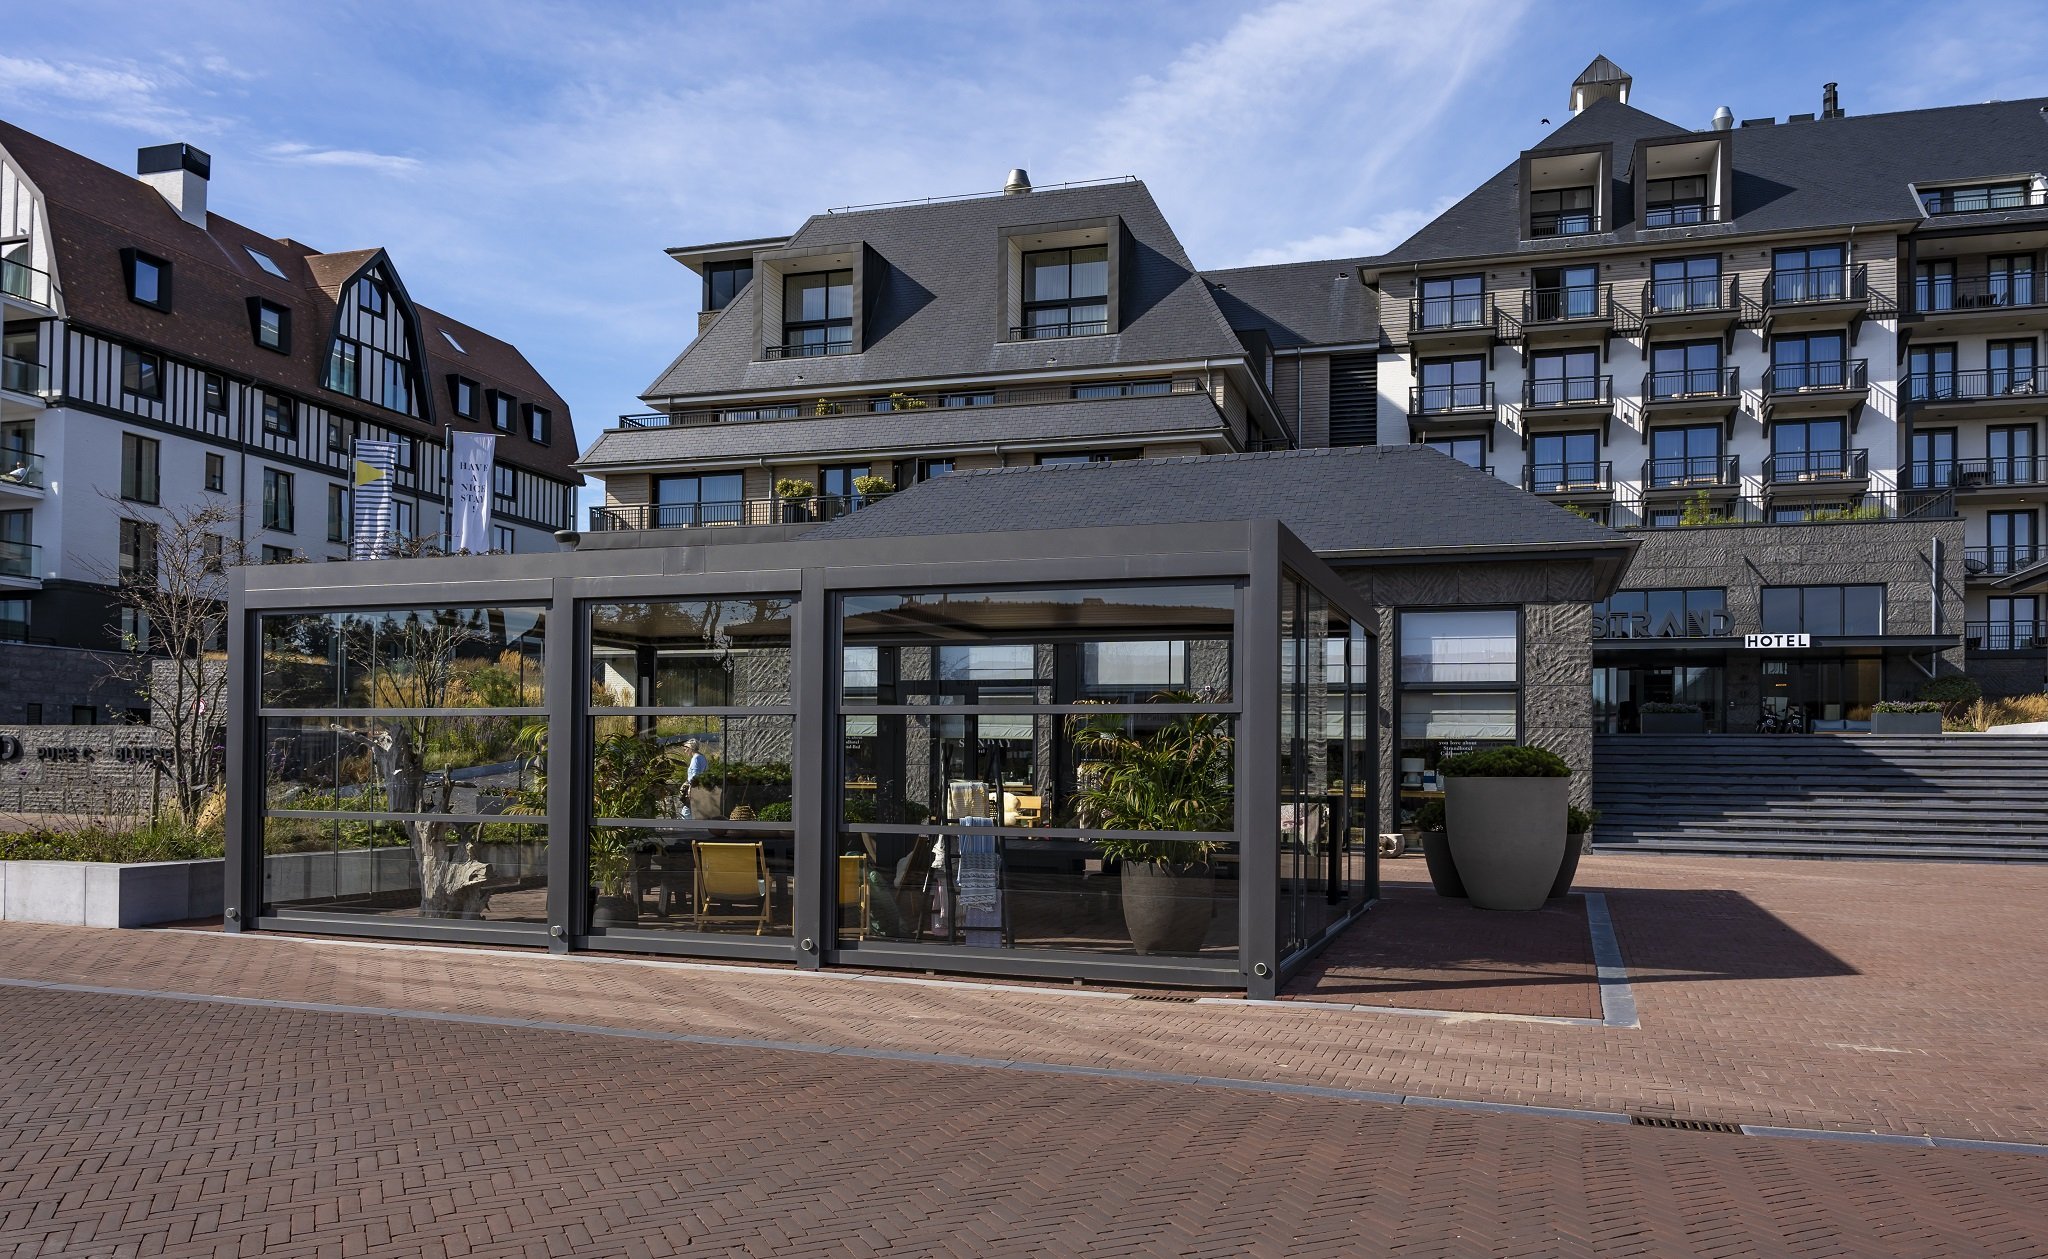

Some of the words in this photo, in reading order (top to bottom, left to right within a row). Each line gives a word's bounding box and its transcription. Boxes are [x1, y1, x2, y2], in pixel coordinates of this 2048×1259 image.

[460, 462, 489, 472] HAVE
[471, 474, 477, 482] A
[461, 483, 486, 493] NICE
[460, 494, 486, 504] STAY
[1592, 609, 1736, 638] STRAND
[1747, 635, 1807, 647] HOTEL
[959, 739, 1012, 748] SNDAY
[38, 746, 77, 760] PURE
